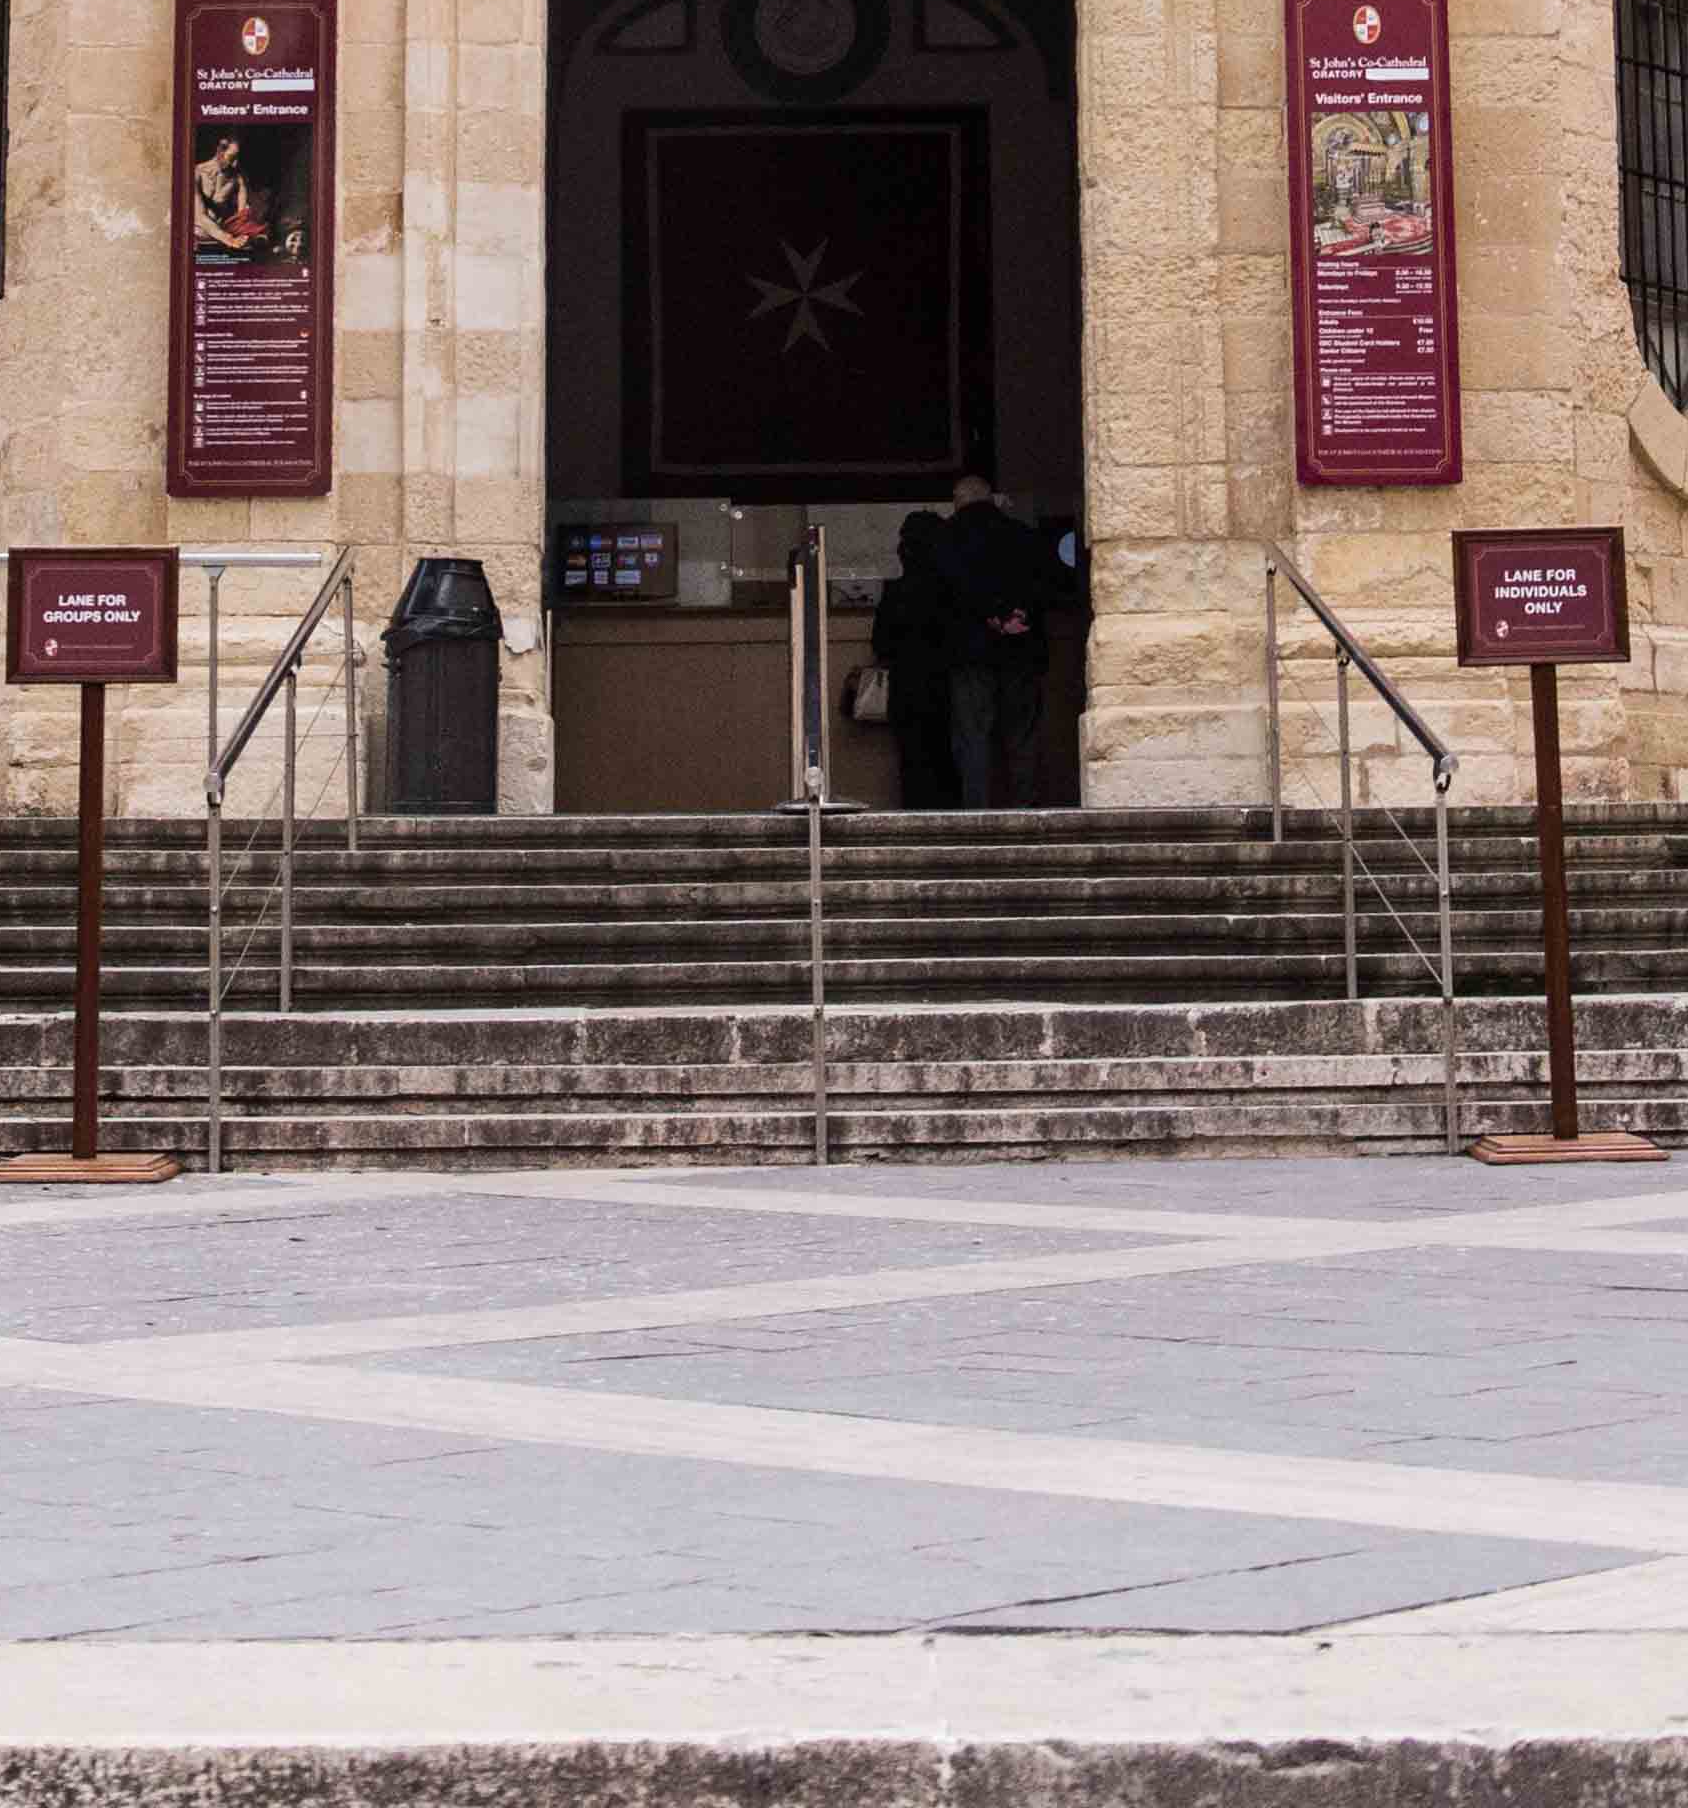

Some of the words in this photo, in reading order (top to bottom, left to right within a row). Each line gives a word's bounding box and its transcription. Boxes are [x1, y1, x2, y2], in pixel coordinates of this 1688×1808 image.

[1309, 57, 1320, 68] St
[1324, 56, 1356, 69] John's
[1358, 56, 1427, 68] Co-Cathedral
[197, 69, 208, 79] St
[211, 68, 243, 80] John's
[245, 68, 314, 79] Co-Cathedral
[1312, 70, 1363, 79] ORATORY
[199, 81, 249, 90] ORATORY
[1315, 93, 1365, 105] Visitors'
[1368, 92, 1423, 104] Entrance
[201, 104, 250, 116] Visitors'
[253, 104, 309, 115] Entrance
[1504, 570, 1542, 582] LANE
[1546, 569, 1576, 581] FOR
[1495, 585, 1587, 598] INDIVIDUALS
[58, 595, 94, 606] LANE
[97, 595, 126, 606] FOR
[1524, 602, 1563, 614] ONLY
[43, 611, 101, 623] GROUPS
[104, 611, 141, 623] ONLY
